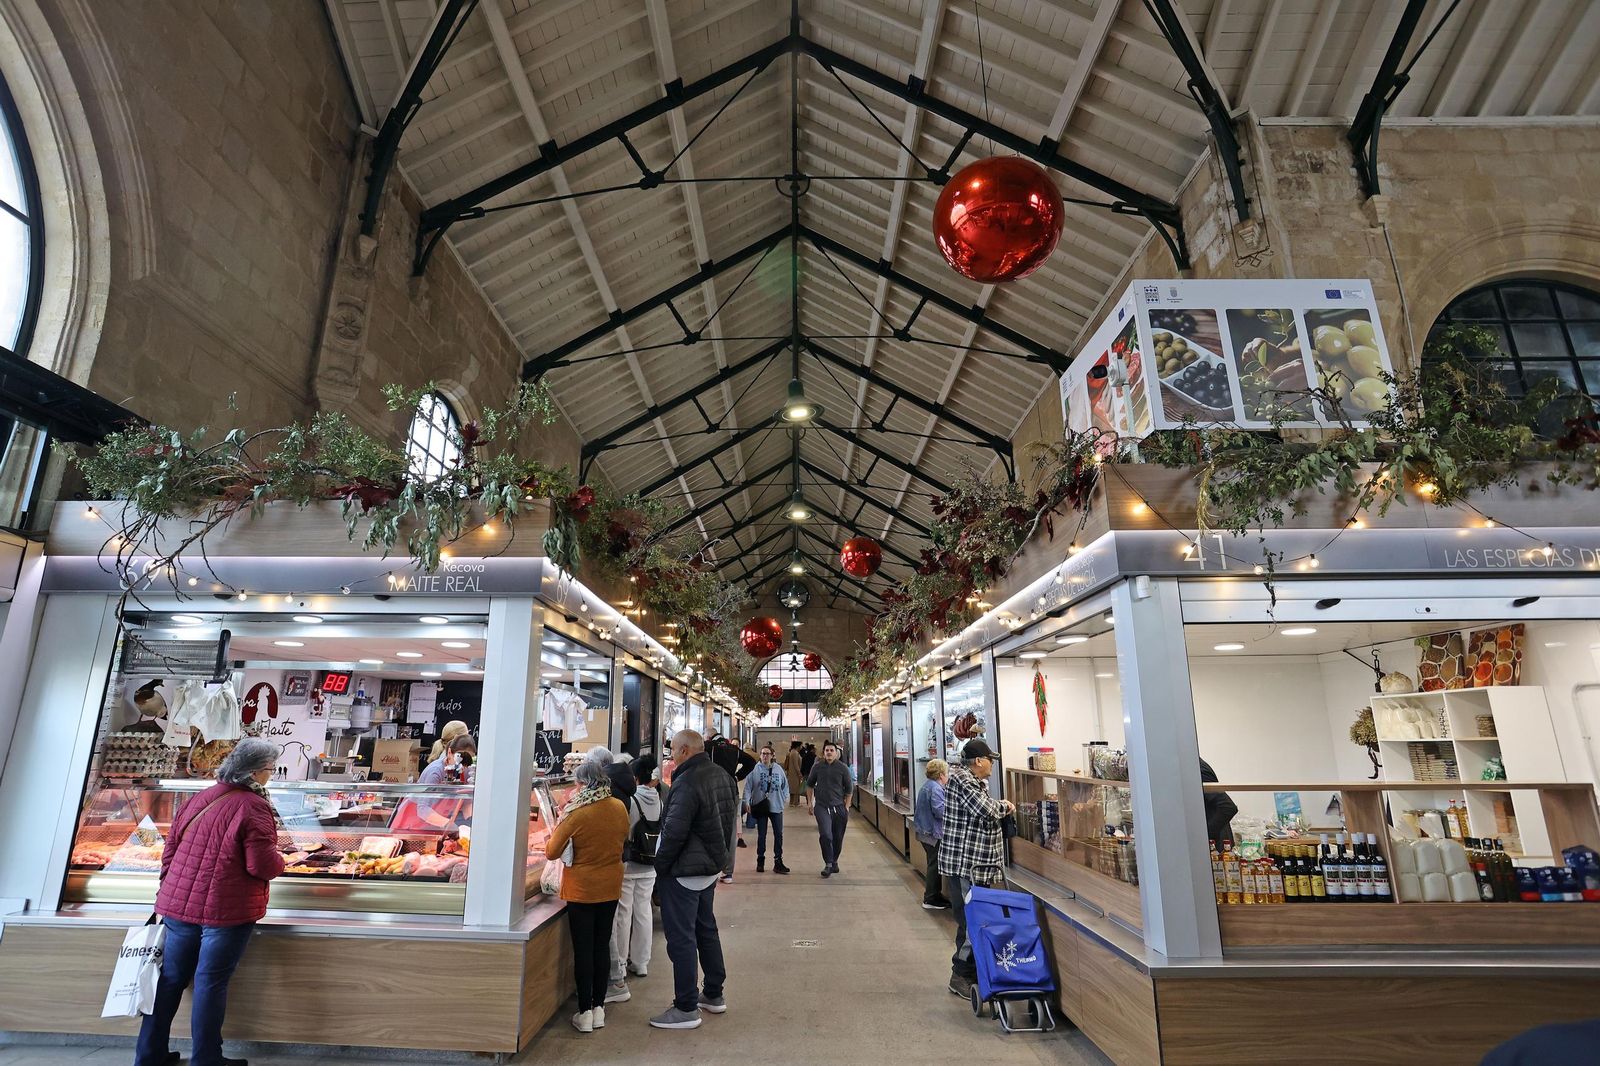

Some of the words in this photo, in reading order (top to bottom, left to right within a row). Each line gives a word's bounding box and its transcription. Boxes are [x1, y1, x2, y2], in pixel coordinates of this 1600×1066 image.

[1184, 533, 1227, 570] 41
[1445, 549, 1479, 567] LAS
[1483, 549, 1575, 567] ESPECIAS
[120, 559, 160, 591] 69
[443, 560, 485, 573] Recova
[390, 576, 440, 592] MAITE
[445, 576, 483, 592] REAL
[323, 674, 348, 691] 88
